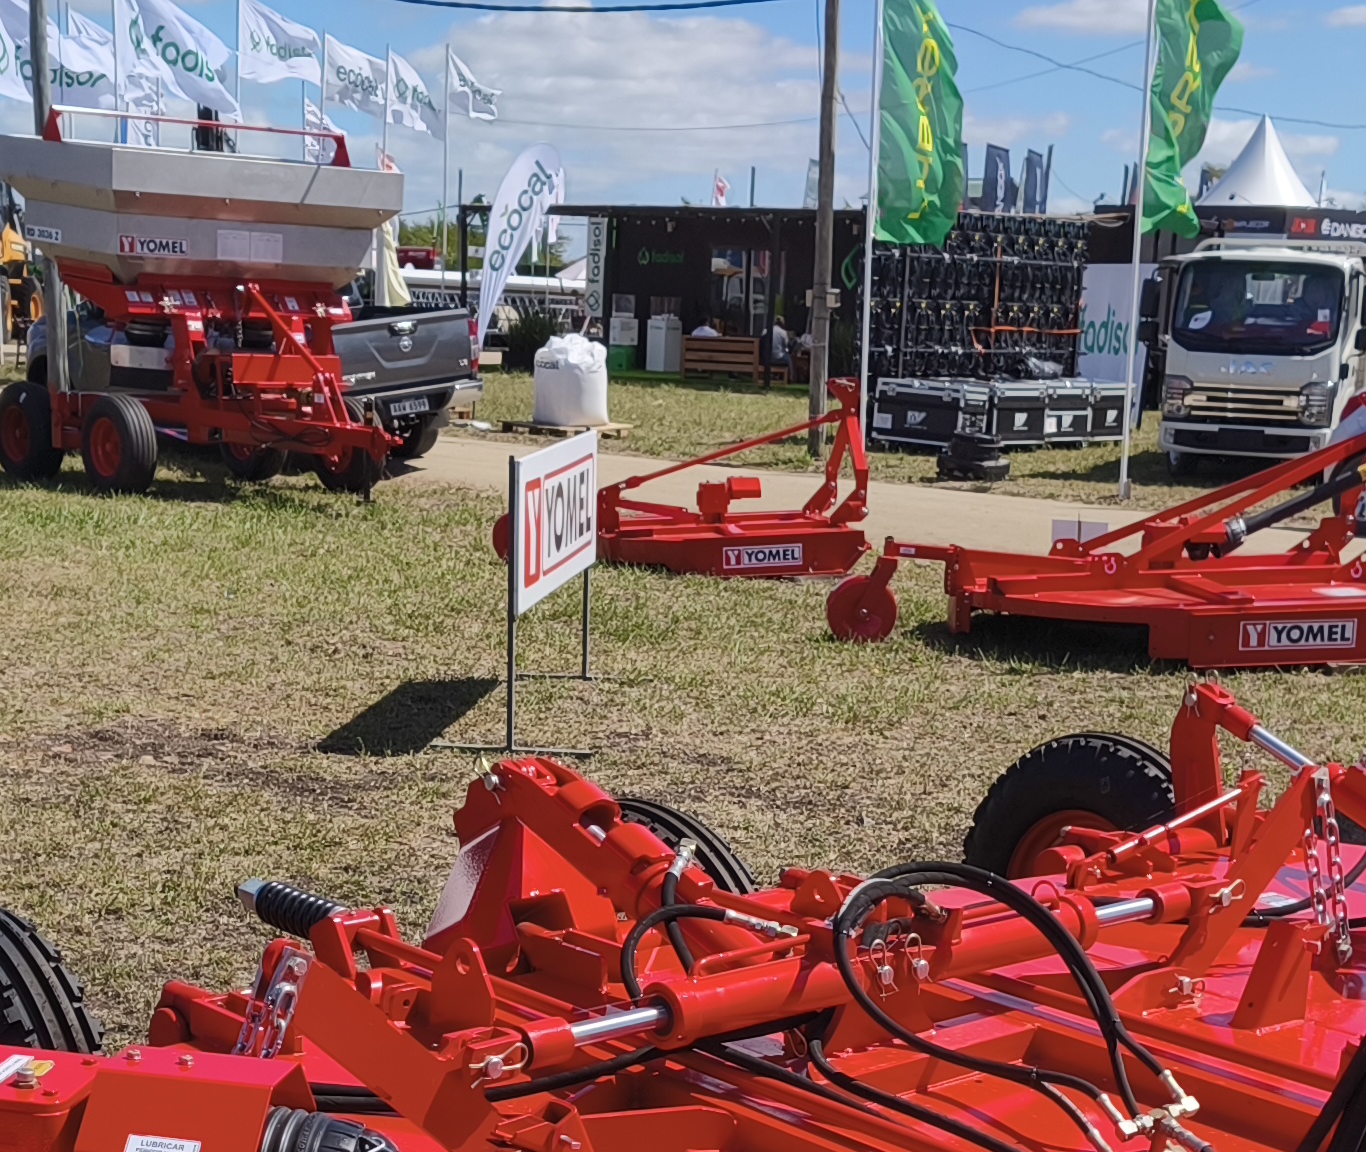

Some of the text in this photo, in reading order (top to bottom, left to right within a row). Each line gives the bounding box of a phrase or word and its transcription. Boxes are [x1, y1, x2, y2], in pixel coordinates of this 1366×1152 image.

[138, 239, 186, 254] YOMEL
[588, 221, 602, 284] fadisol
[545, 468, 592, 558] YOMEL
[745, 549, 799, 563] YOMEL
[1273, 624, 1350, 644] YOMEL
[140, 1139, 185, 1151] LUBRICAR
